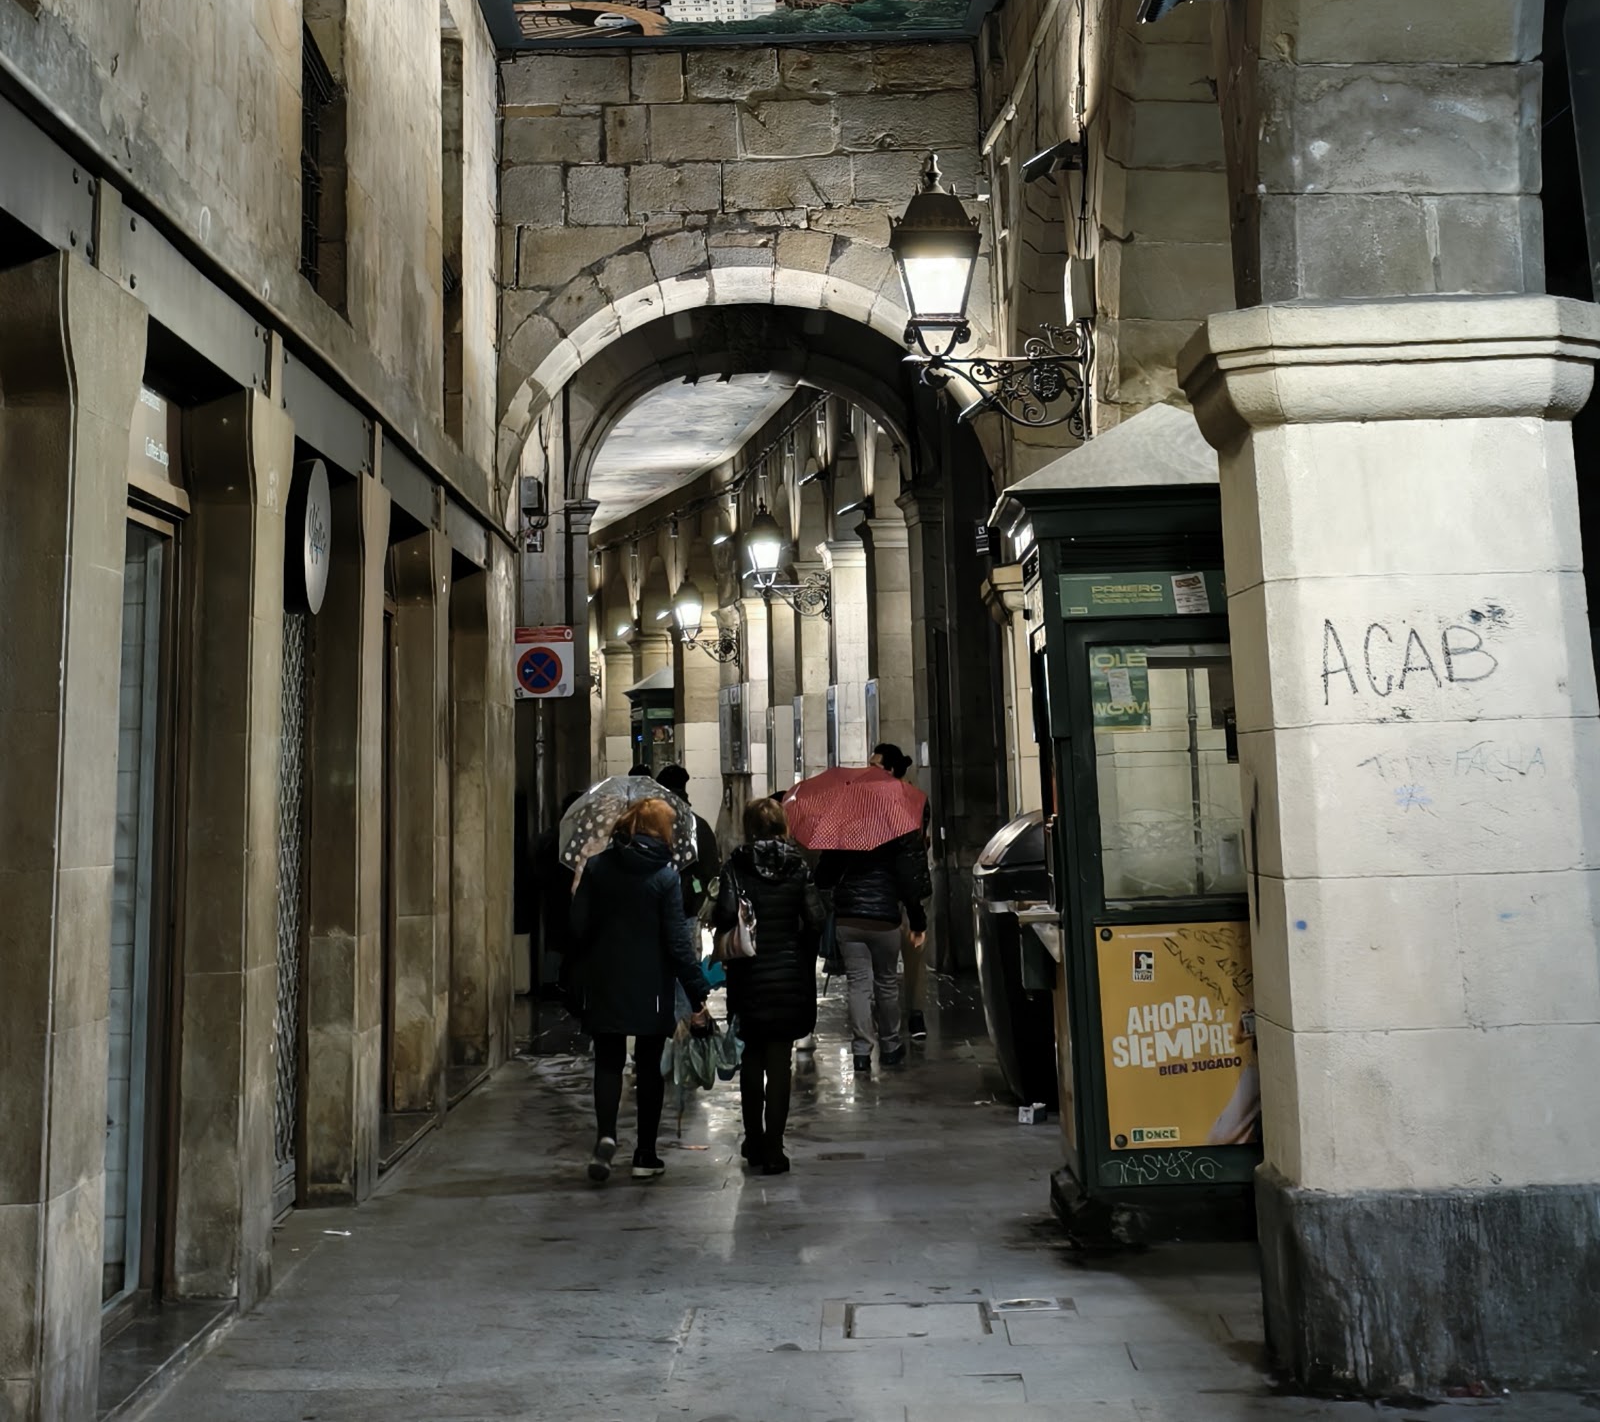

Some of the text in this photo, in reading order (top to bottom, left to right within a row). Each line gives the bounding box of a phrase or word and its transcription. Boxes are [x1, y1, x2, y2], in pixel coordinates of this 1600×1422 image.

[1091, 584, 1163, 594] PRIMERO
[1320, 619, 1498, 706] ACAB
[1127, 994, 1213, 1035] AHORA
[1112, 1022, 1235, 1069] SIEMPRE
[1159, 1056, 1242, 1076] BIEN JUGADO
[1145, 1130, 1178, 1140] ONCE
